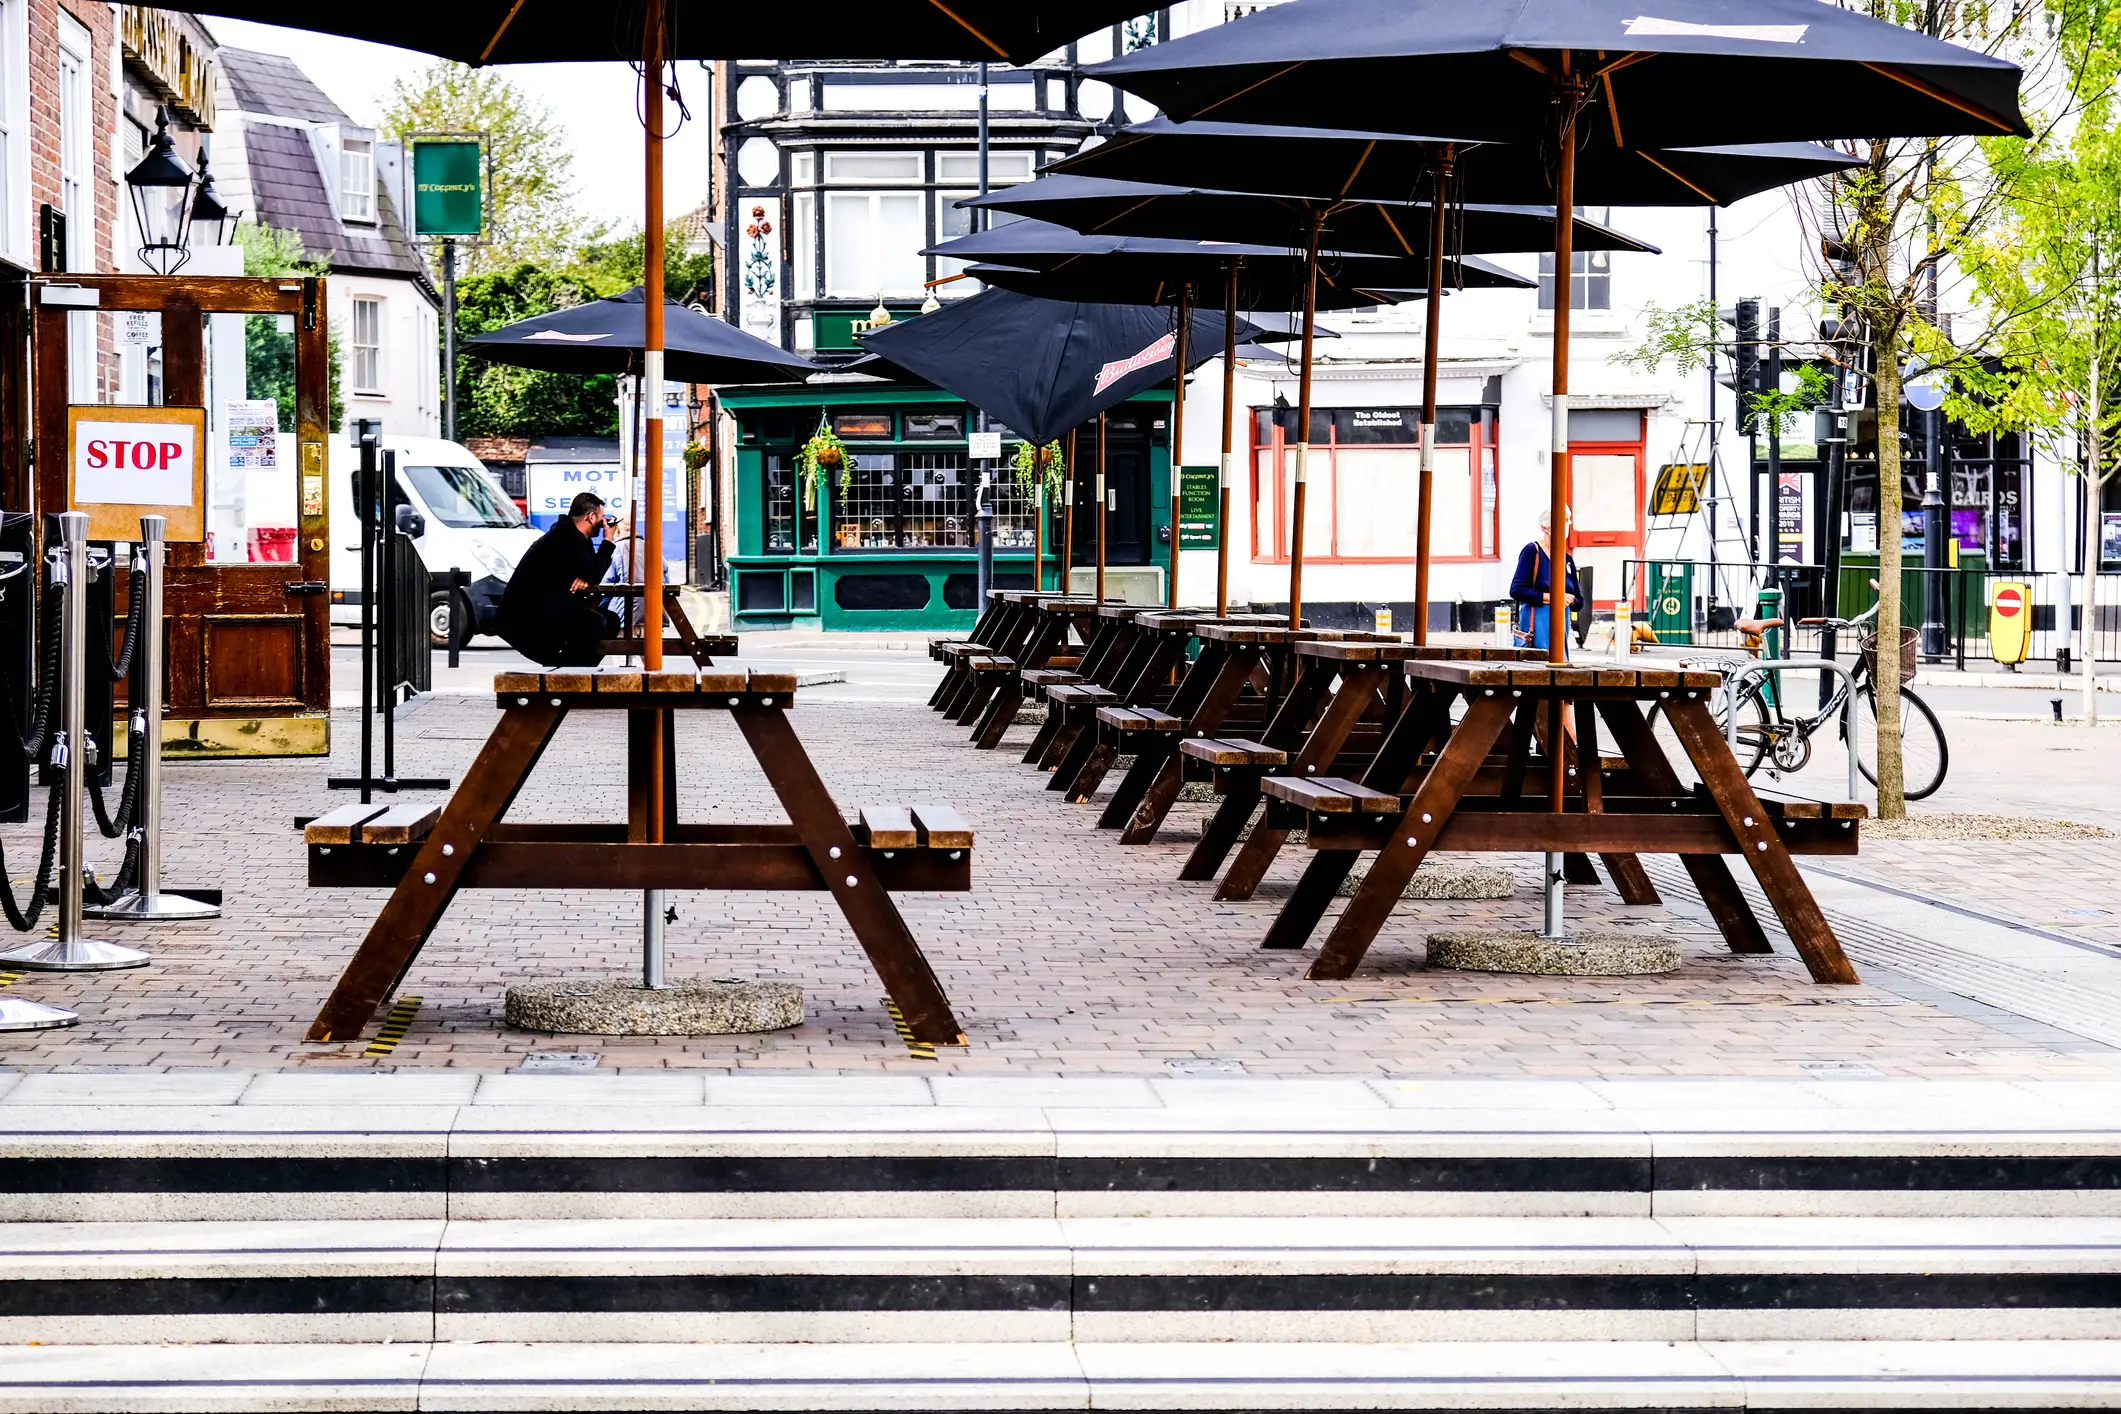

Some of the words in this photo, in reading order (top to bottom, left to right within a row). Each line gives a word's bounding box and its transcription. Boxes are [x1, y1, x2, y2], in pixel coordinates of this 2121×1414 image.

[1095, 339, 1175, 385] Budweiser
[1354, 411, 1372, 419] The
[1372, 411, 1401, 419] Oldest
[86, 440, 183, 470] STOP
[563, 471, 618, 482] MOT
[588, 485, 598, 495] &
[545, 498, 622, 509] SEIC
[1807, 686, 1847, 730] VIKING
